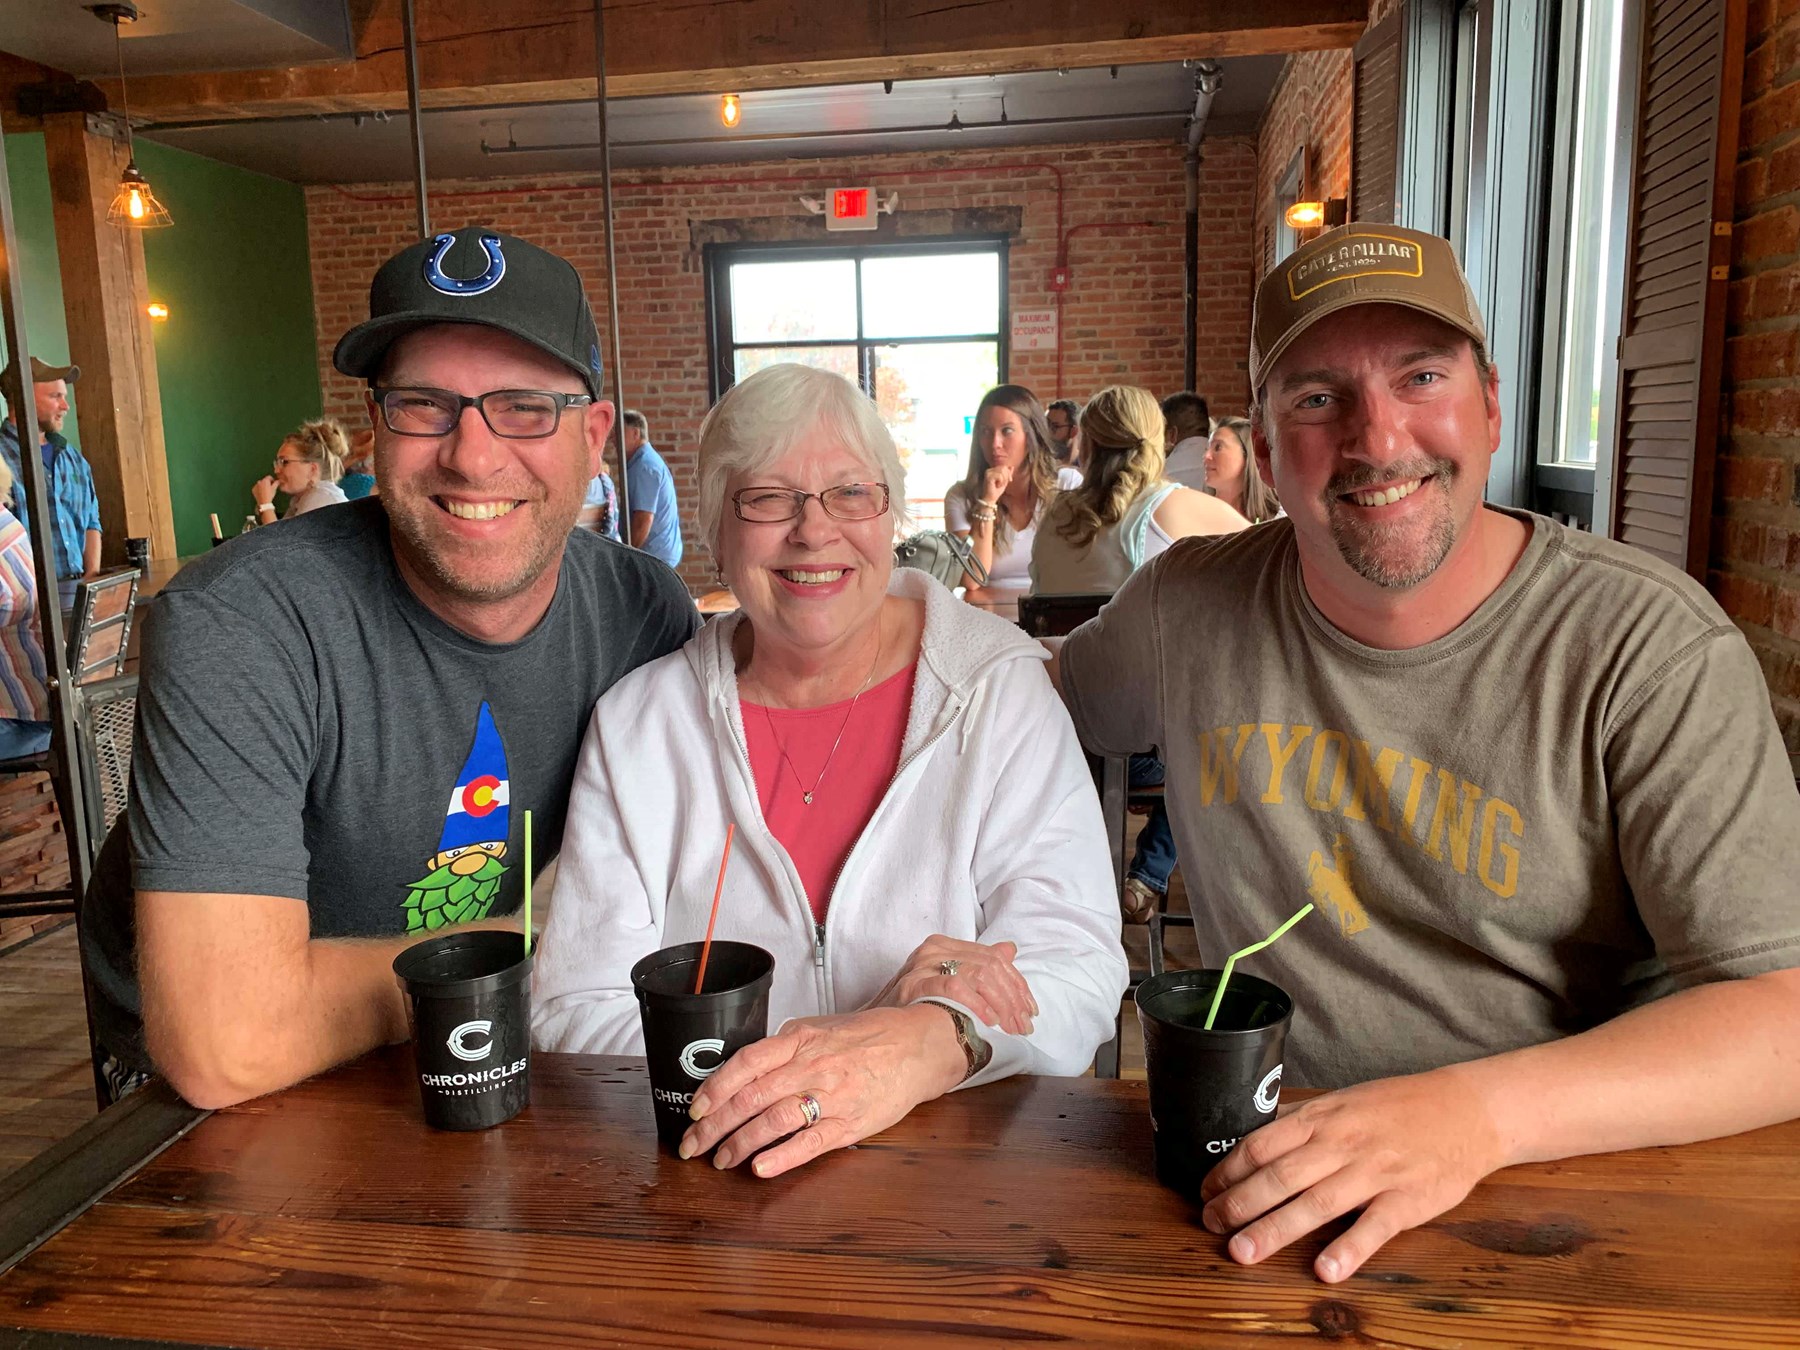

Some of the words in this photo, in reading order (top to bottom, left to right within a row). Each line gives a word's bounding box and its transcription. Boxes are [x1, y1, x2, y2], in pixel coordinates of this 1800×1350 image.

[1298, 242, 1411, 279] CATERPILLAR
[1014, 327, 1054, 335] OCCUPANCY
[1199, 723, 1524, 898] WYOMING
[421, 1057, 527, 1087] CHRONICLES
[445, 1082, 506, 1096] DISTILLING
